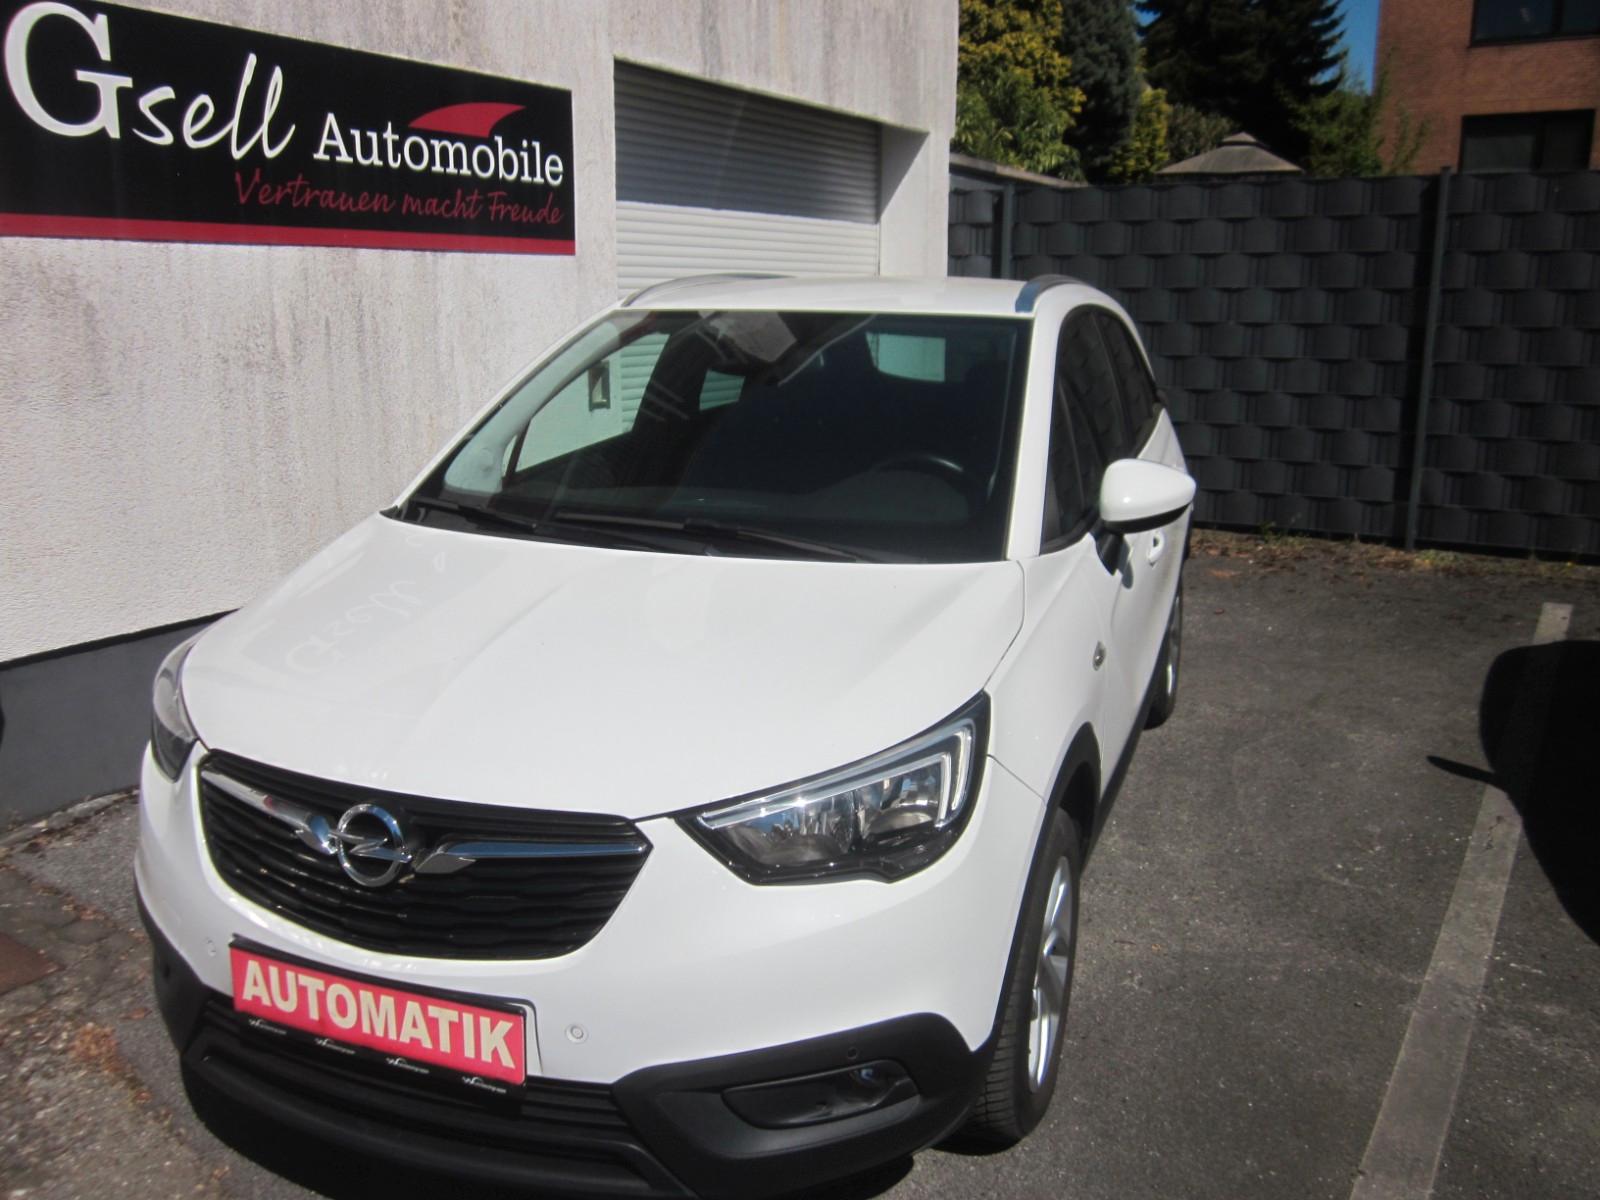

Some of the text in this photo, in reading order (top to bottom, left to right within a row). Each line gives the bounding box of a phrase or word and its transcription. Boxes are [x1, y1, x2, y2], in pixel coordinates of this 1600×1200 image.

[4, 1, 564, 186] Gsell Automobile
[234, 169, 563, 225] Vertrauen macht Freude
[242, 959, 516, 1070] AUTOMATIK
